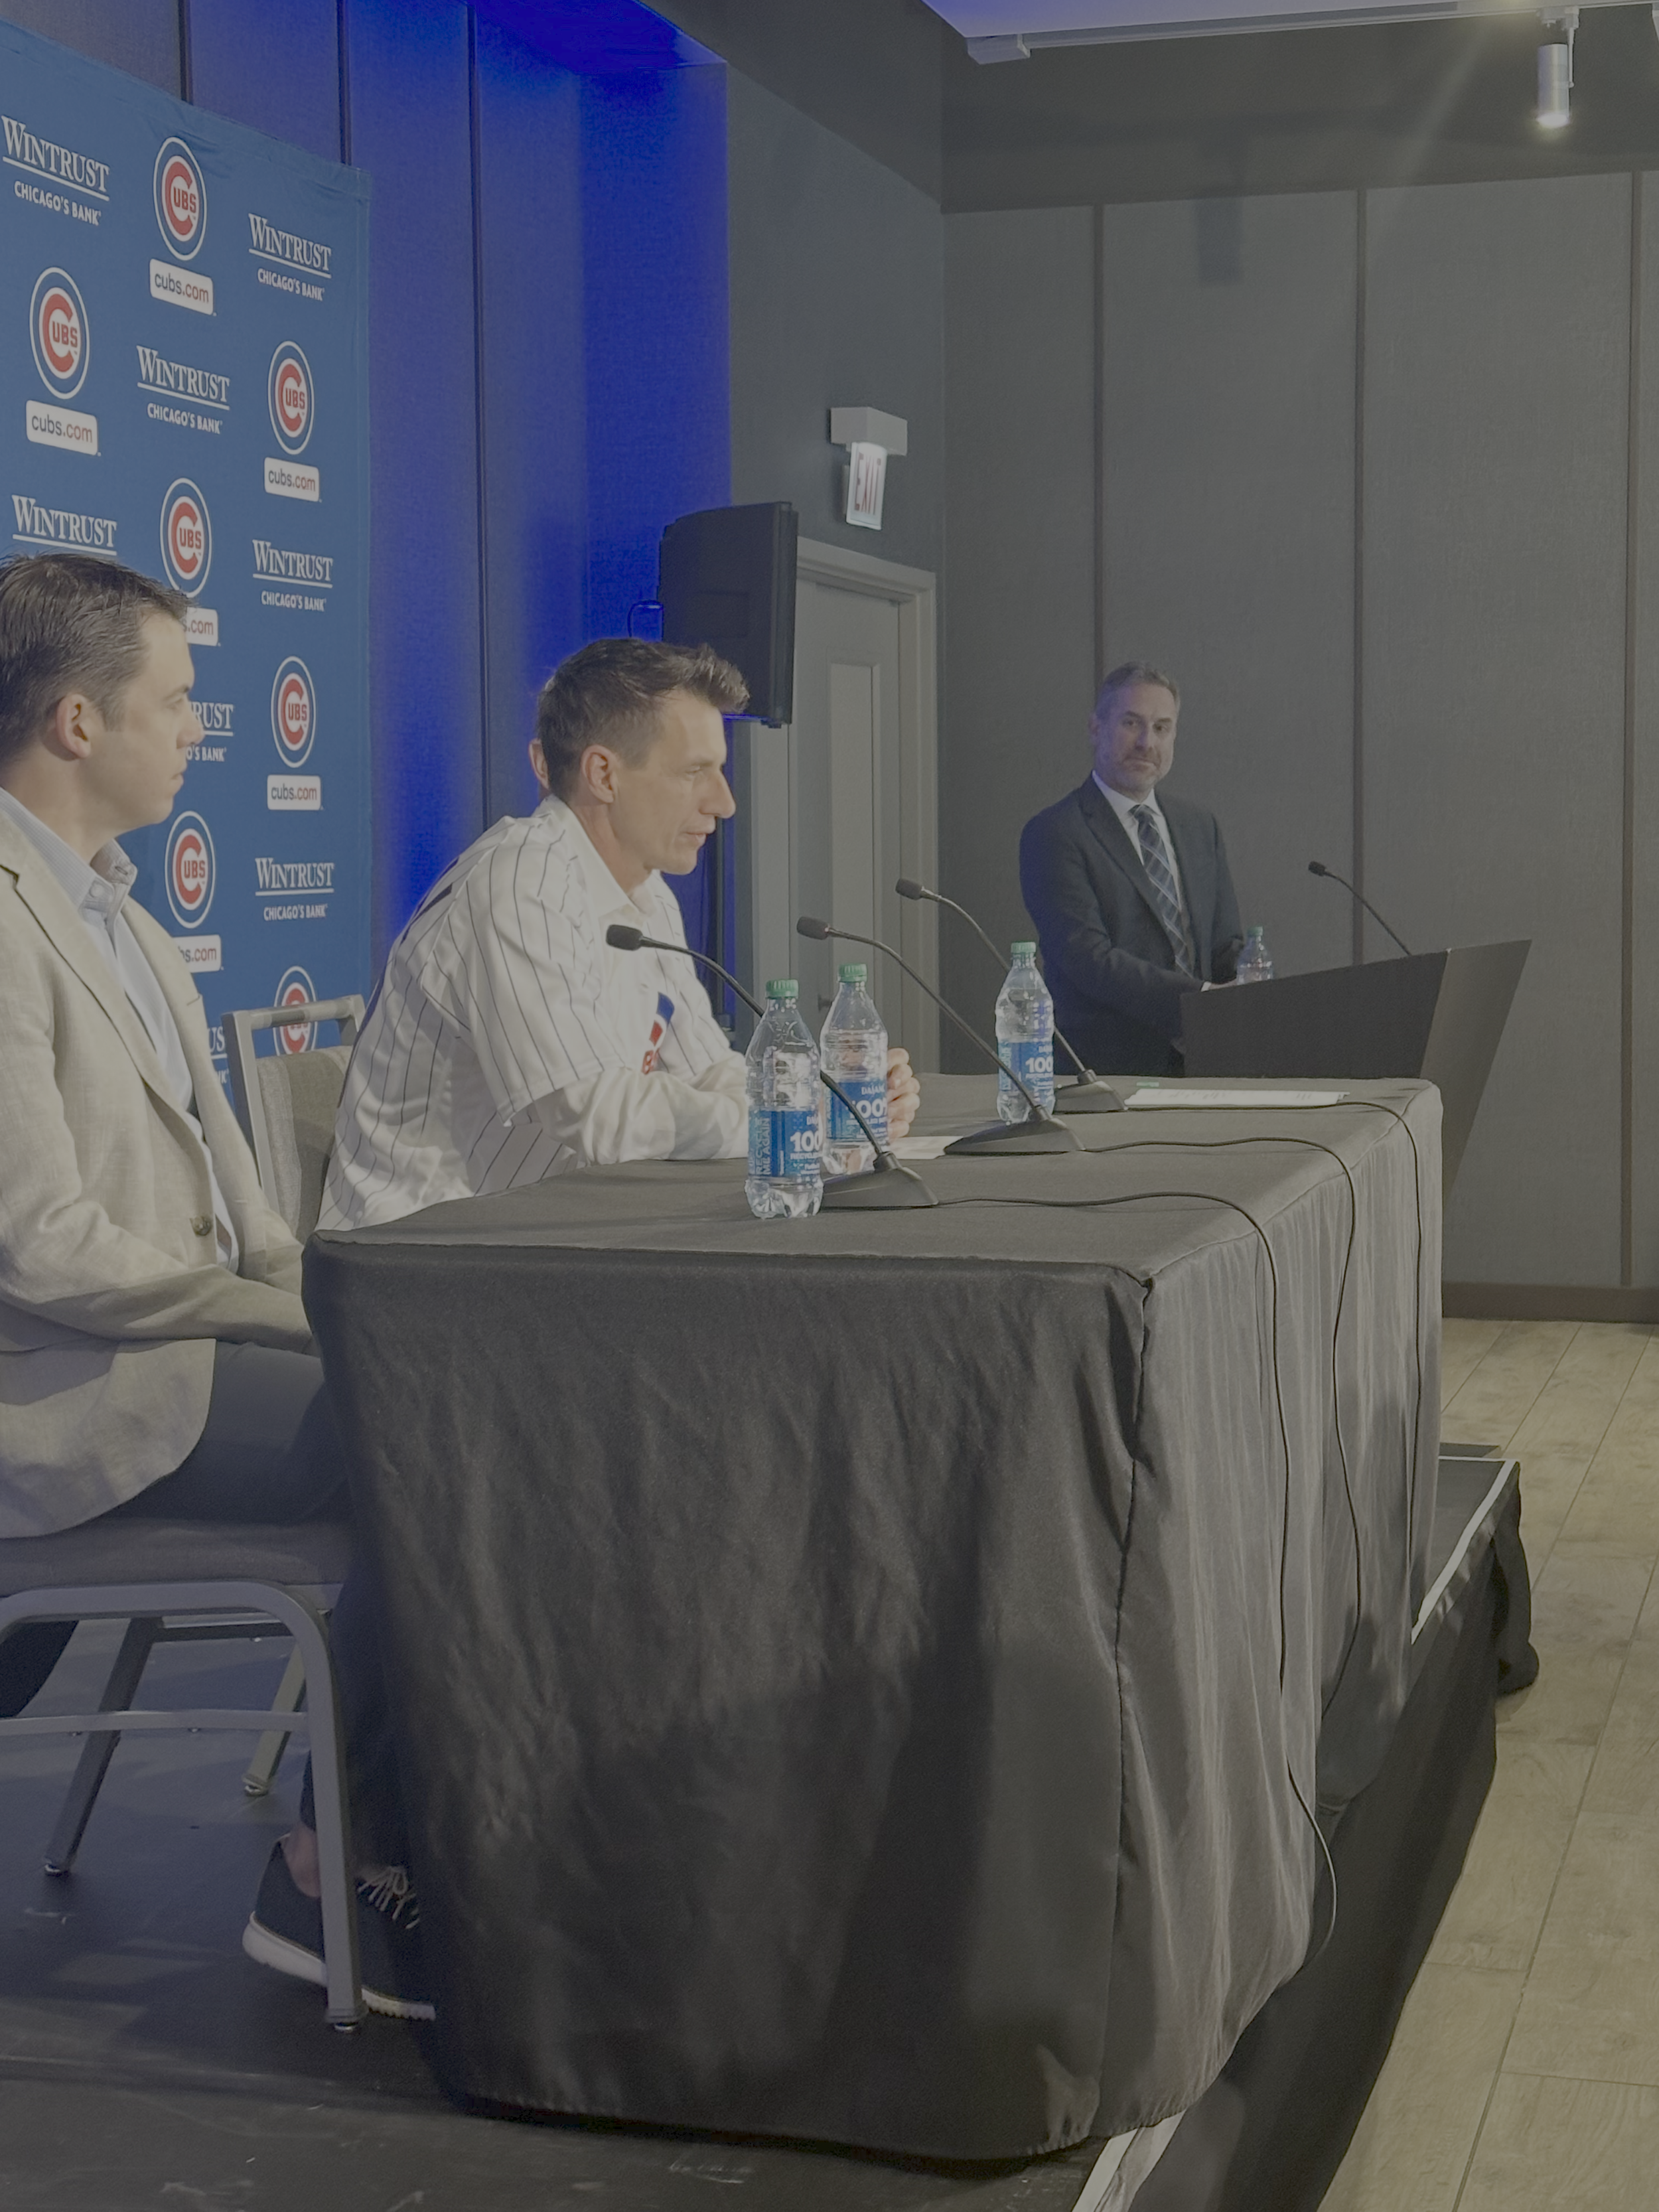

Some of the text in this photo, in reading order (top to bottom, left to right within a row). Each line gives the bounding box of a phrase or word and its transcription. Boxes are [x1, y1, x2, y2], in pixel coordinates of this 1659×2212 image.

[1, 115, 110, 192] WINTRUST
[14, 181, 70, 215] CHICAGO'S
[248, 212, 332, 271] WINTRUST
[155, 272, 210, 303] cubs.com
[257, 267, 301, 295] CHICAGO'S
[136, 344, 230, 402] WINTRUST
[32, 413, 93, 444] cubs.com
[147, 402, 195, 429] CHICAGO'S
[268, 468, 316, 492] cubs.com
[854, 452, 882, 516] EXIT
[11, 494, 117, 548] WINTRUST
[252, 539, 334, 581] WINTRUST
[261, 590, 303, 609] CHICAGO'S
[189, 701, 234, 729] RUST
[271, 783, 317, 801] cubs.com
[255, 857, 334, 889] WINTRUST
[263, 904, 305, 921] CHICAGO'S
